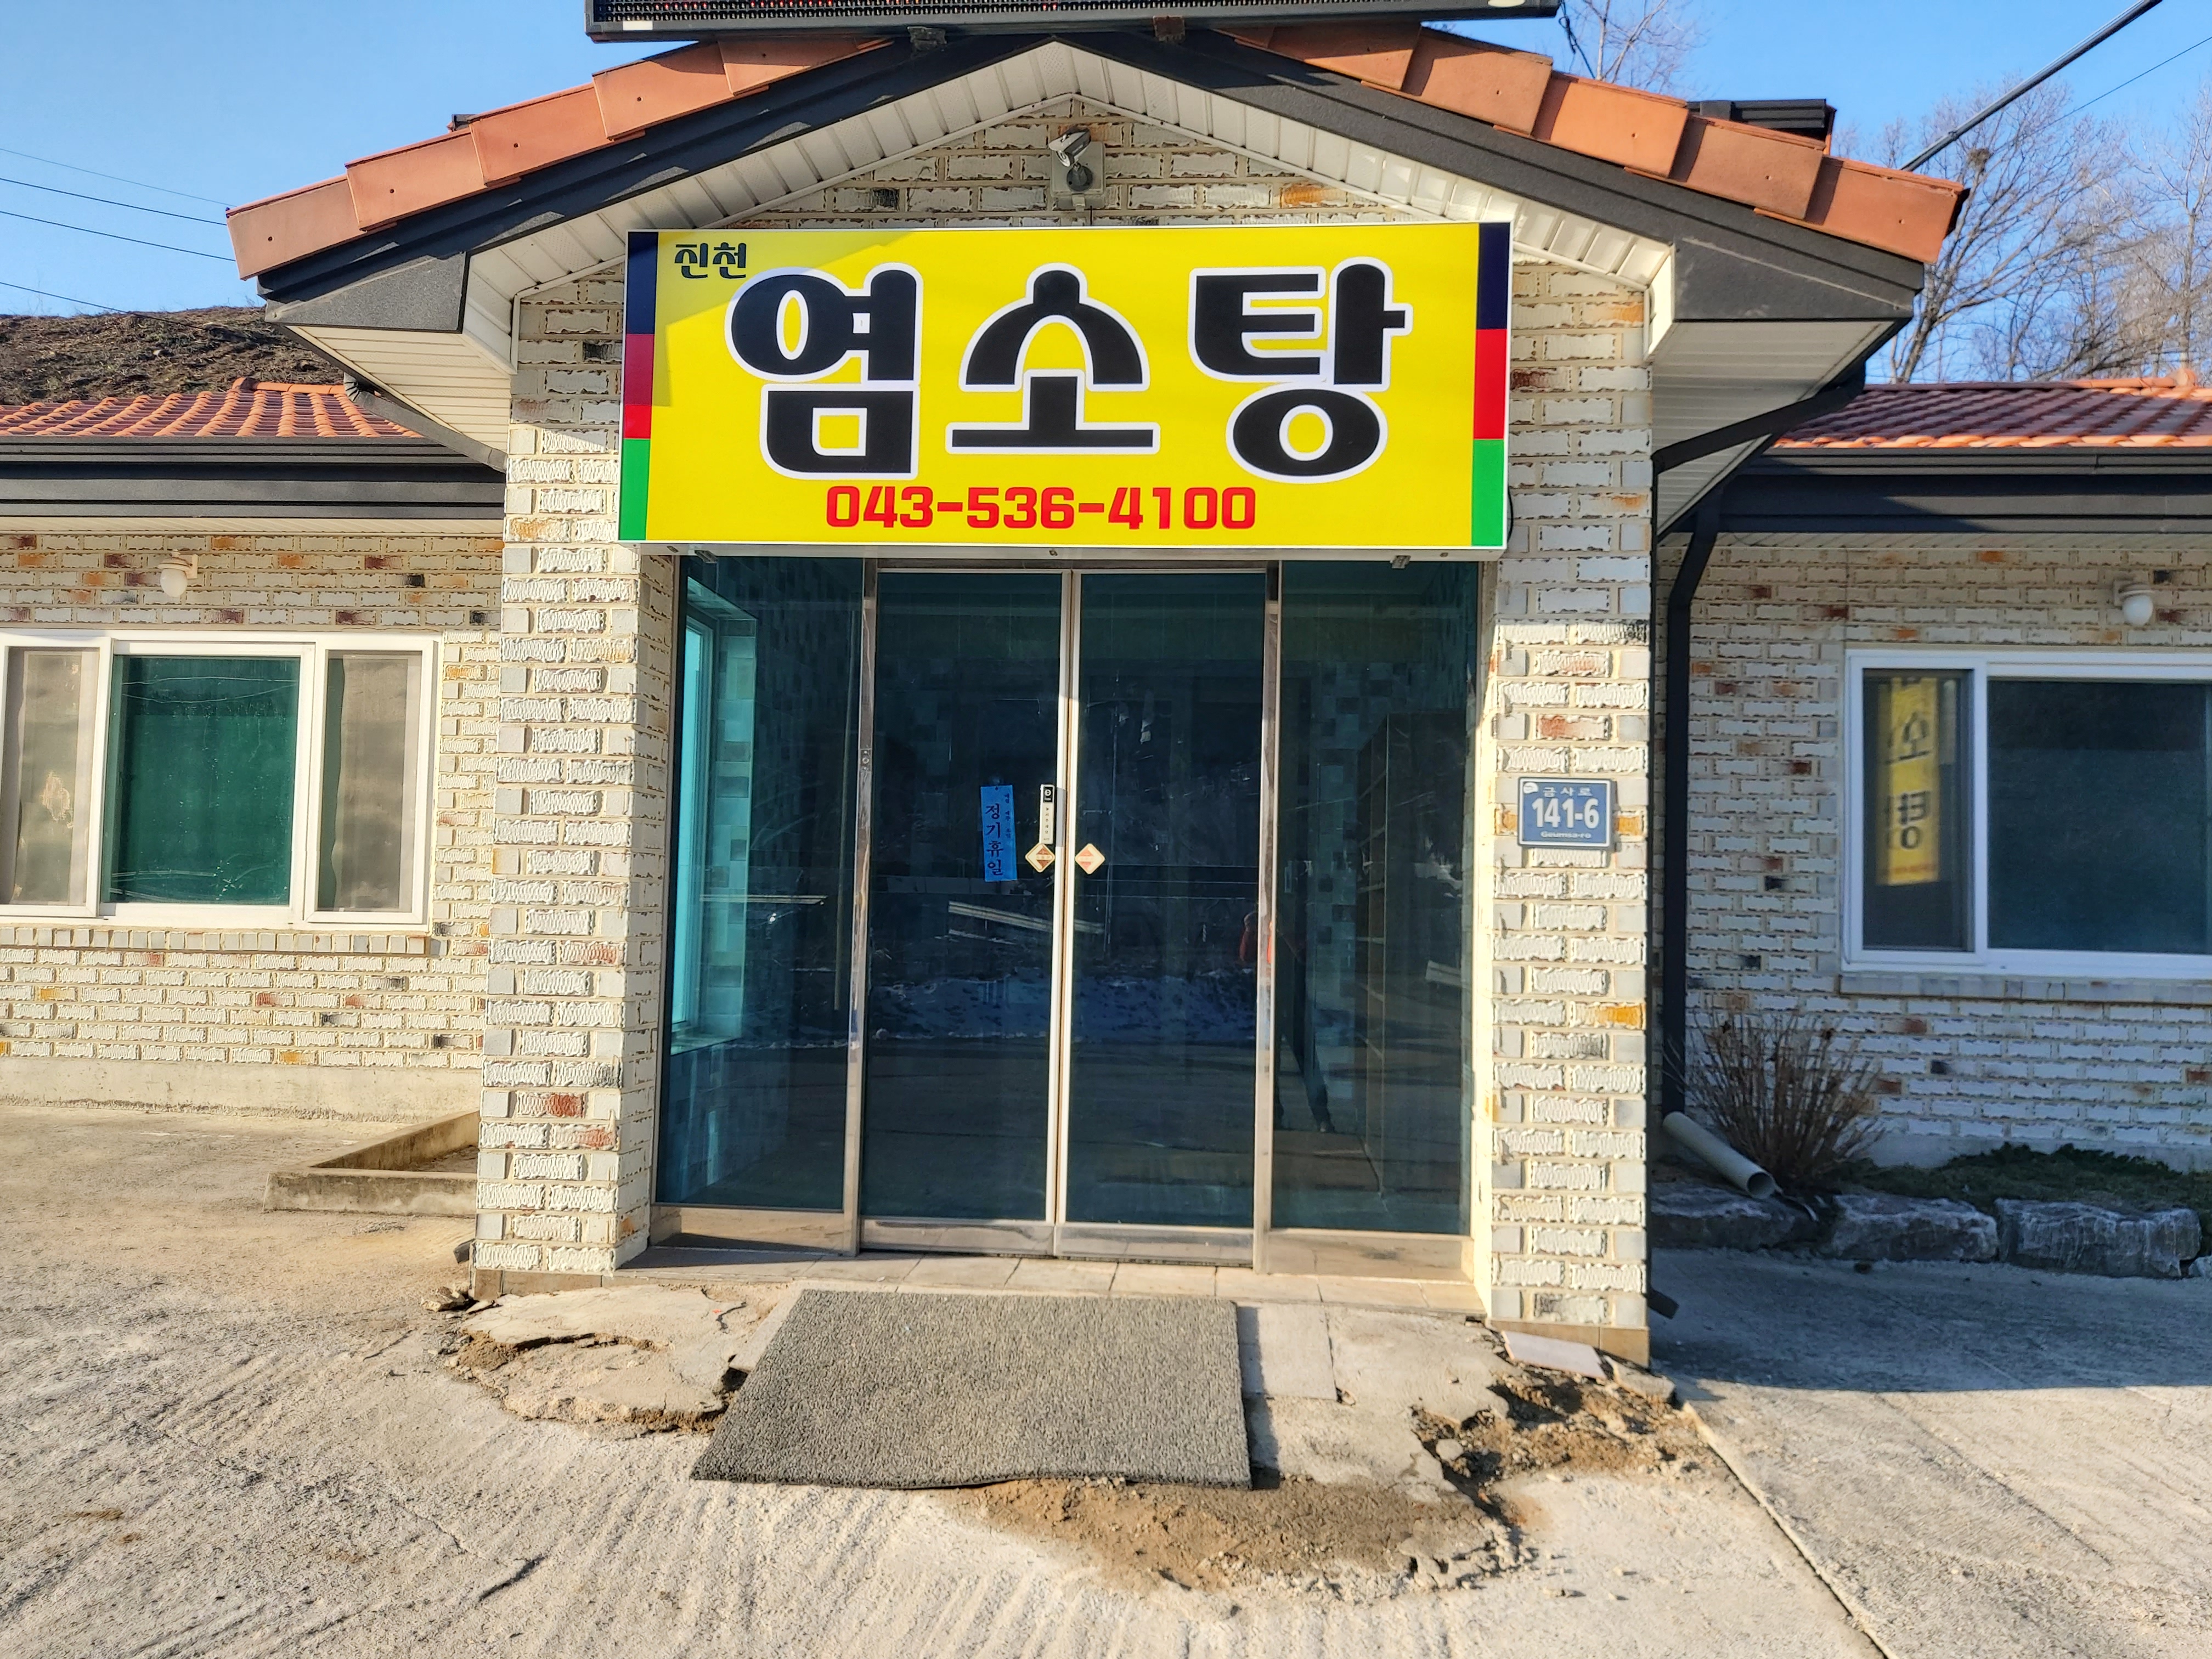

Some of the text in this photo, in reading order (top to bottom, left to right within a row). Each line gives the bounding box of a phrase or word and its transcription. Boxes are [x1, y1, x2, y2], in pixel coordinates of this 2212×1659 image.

[675, 242, 747, 279] 진천
[731, 263, 1406, 476] 염소탕
[827, 486, 1256, 529] 043-536-4100
[1543, 787, 1593, 797] 금사로
[1532, 798, 1599, 829] 141-6
[985, 803, 1004, 876] 정기휴일
